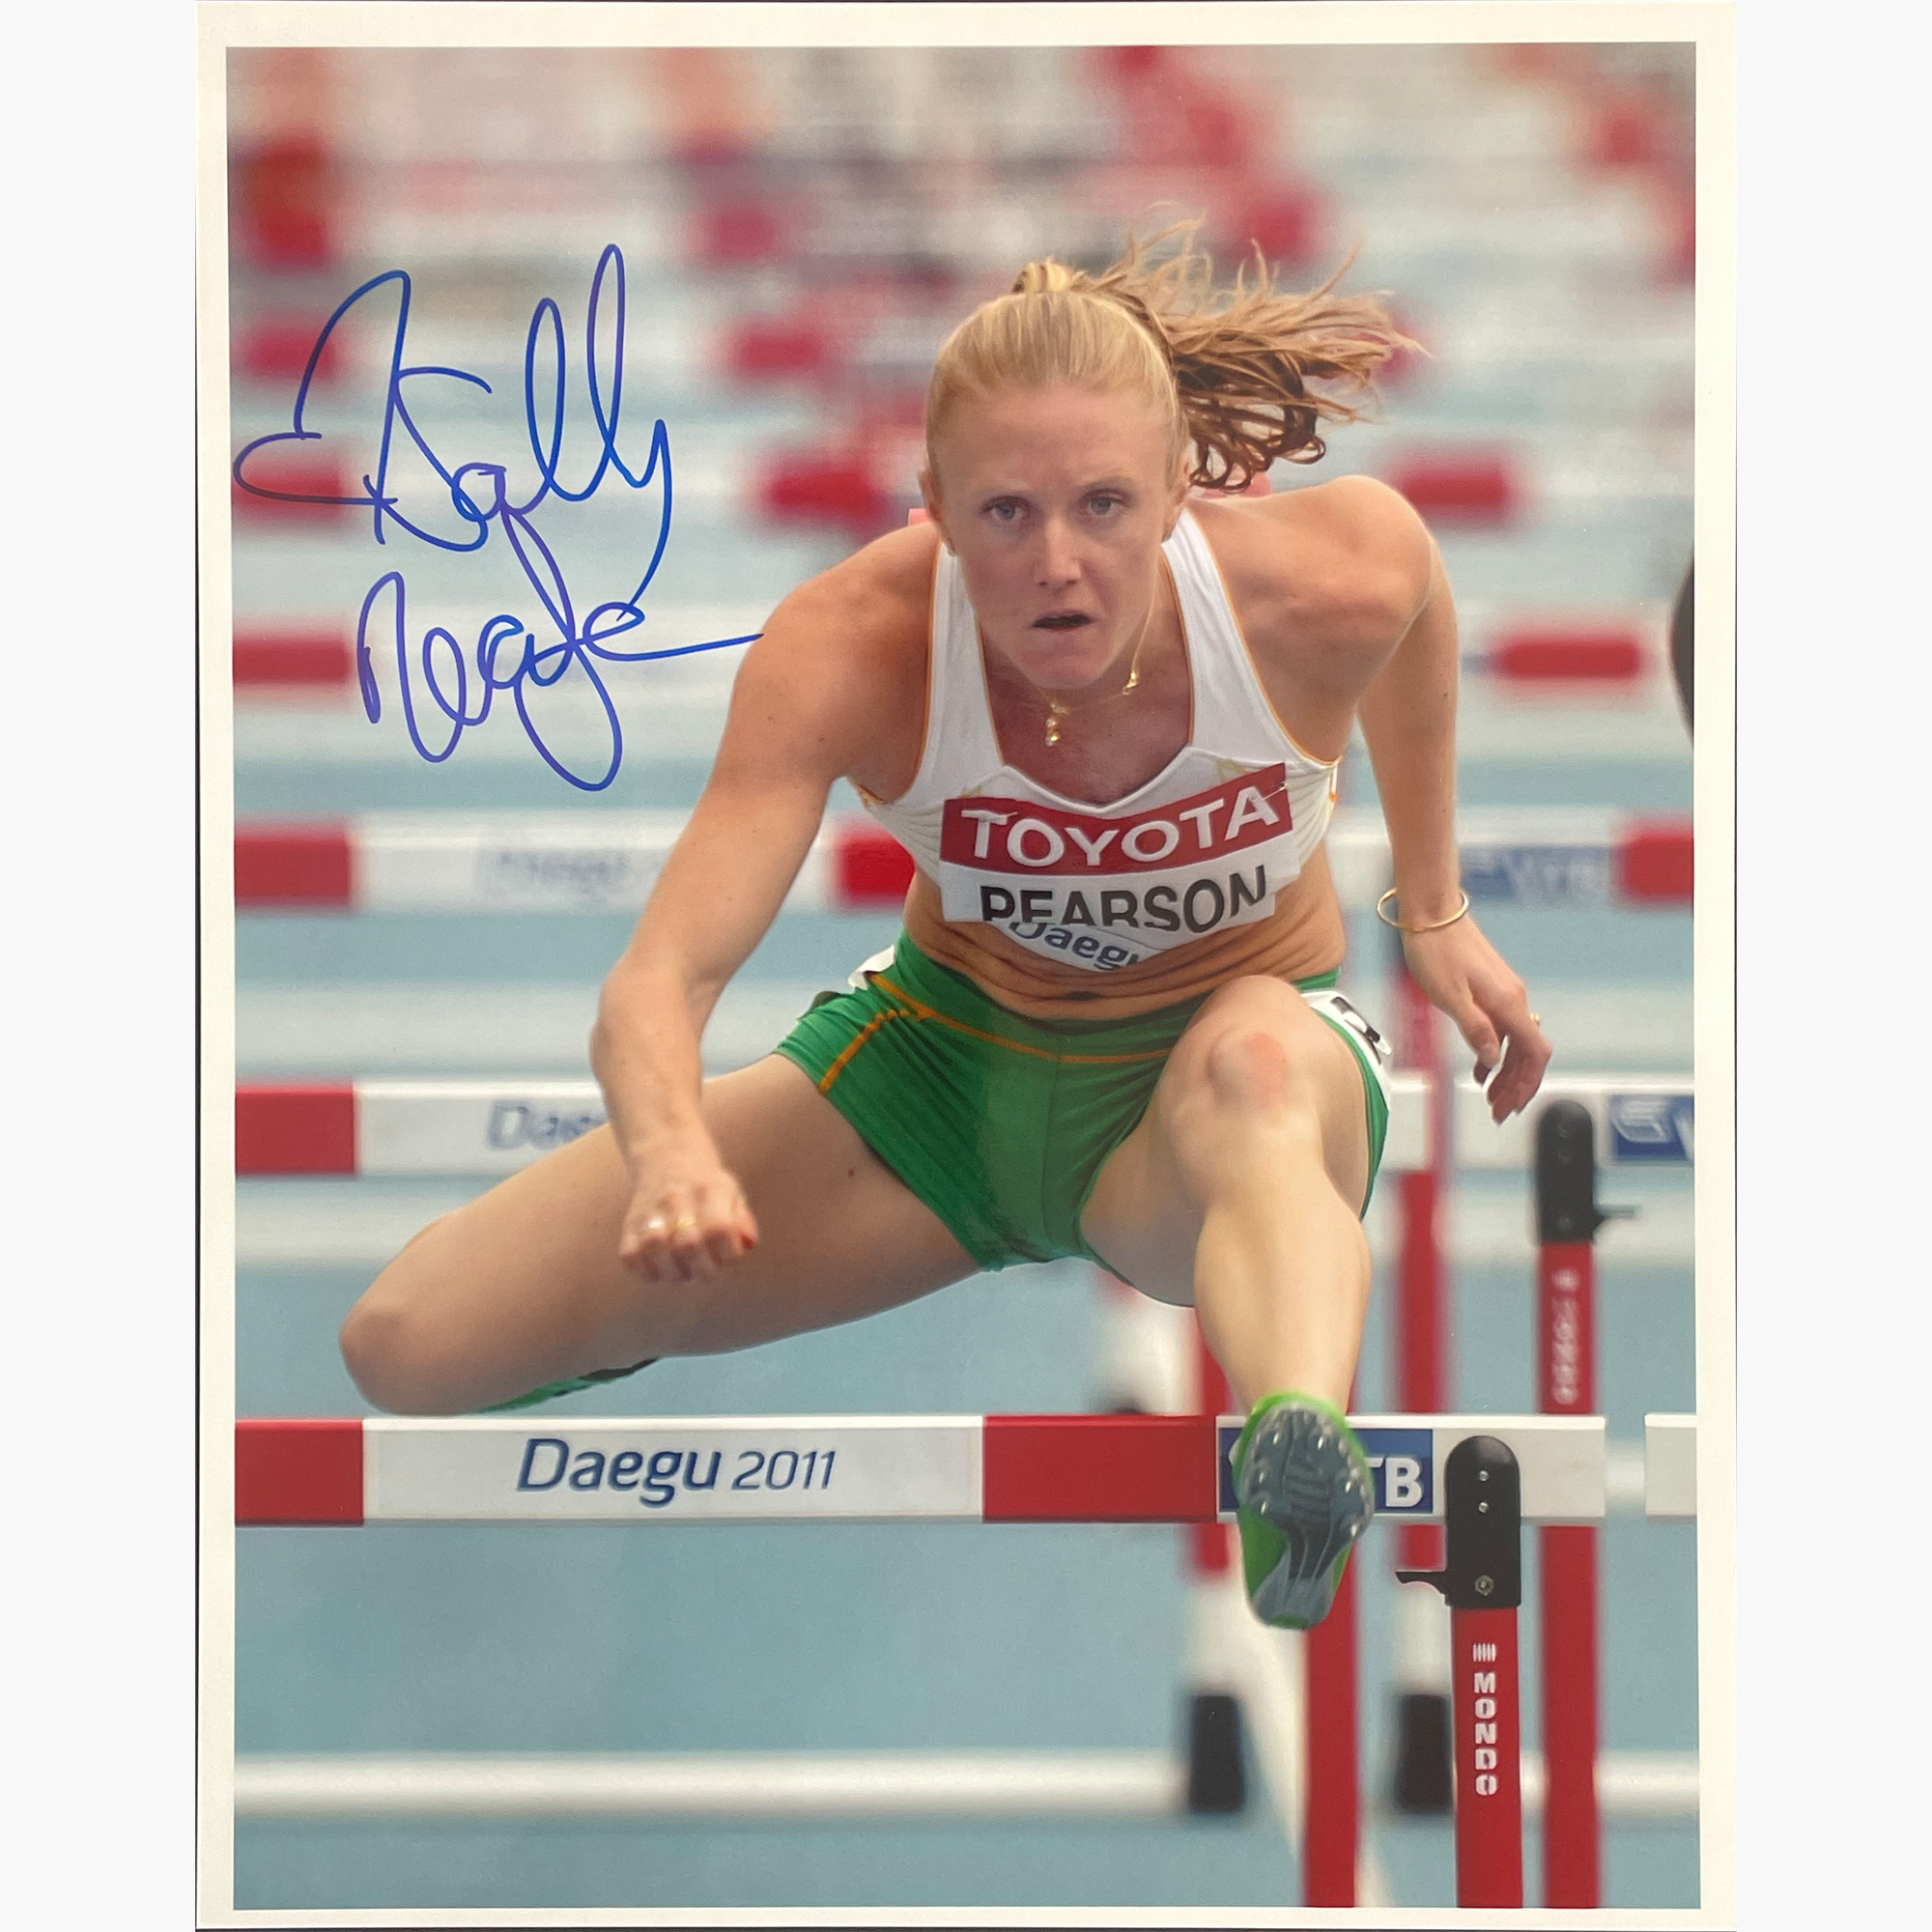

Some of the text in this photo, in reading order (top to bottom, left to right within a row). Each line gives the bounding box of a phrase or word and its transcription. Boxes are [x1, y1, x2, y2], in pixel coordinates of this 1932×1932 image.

[960, 784, 1281, 867] TOYOTA
[979, 864, 1266, 934] PEARSON
[1009, 921, 1140, 972] Daeg
[516, 1437, 837, 1509] Daegu 2011
[1473, 1671, 1498, 1796] MONDO
